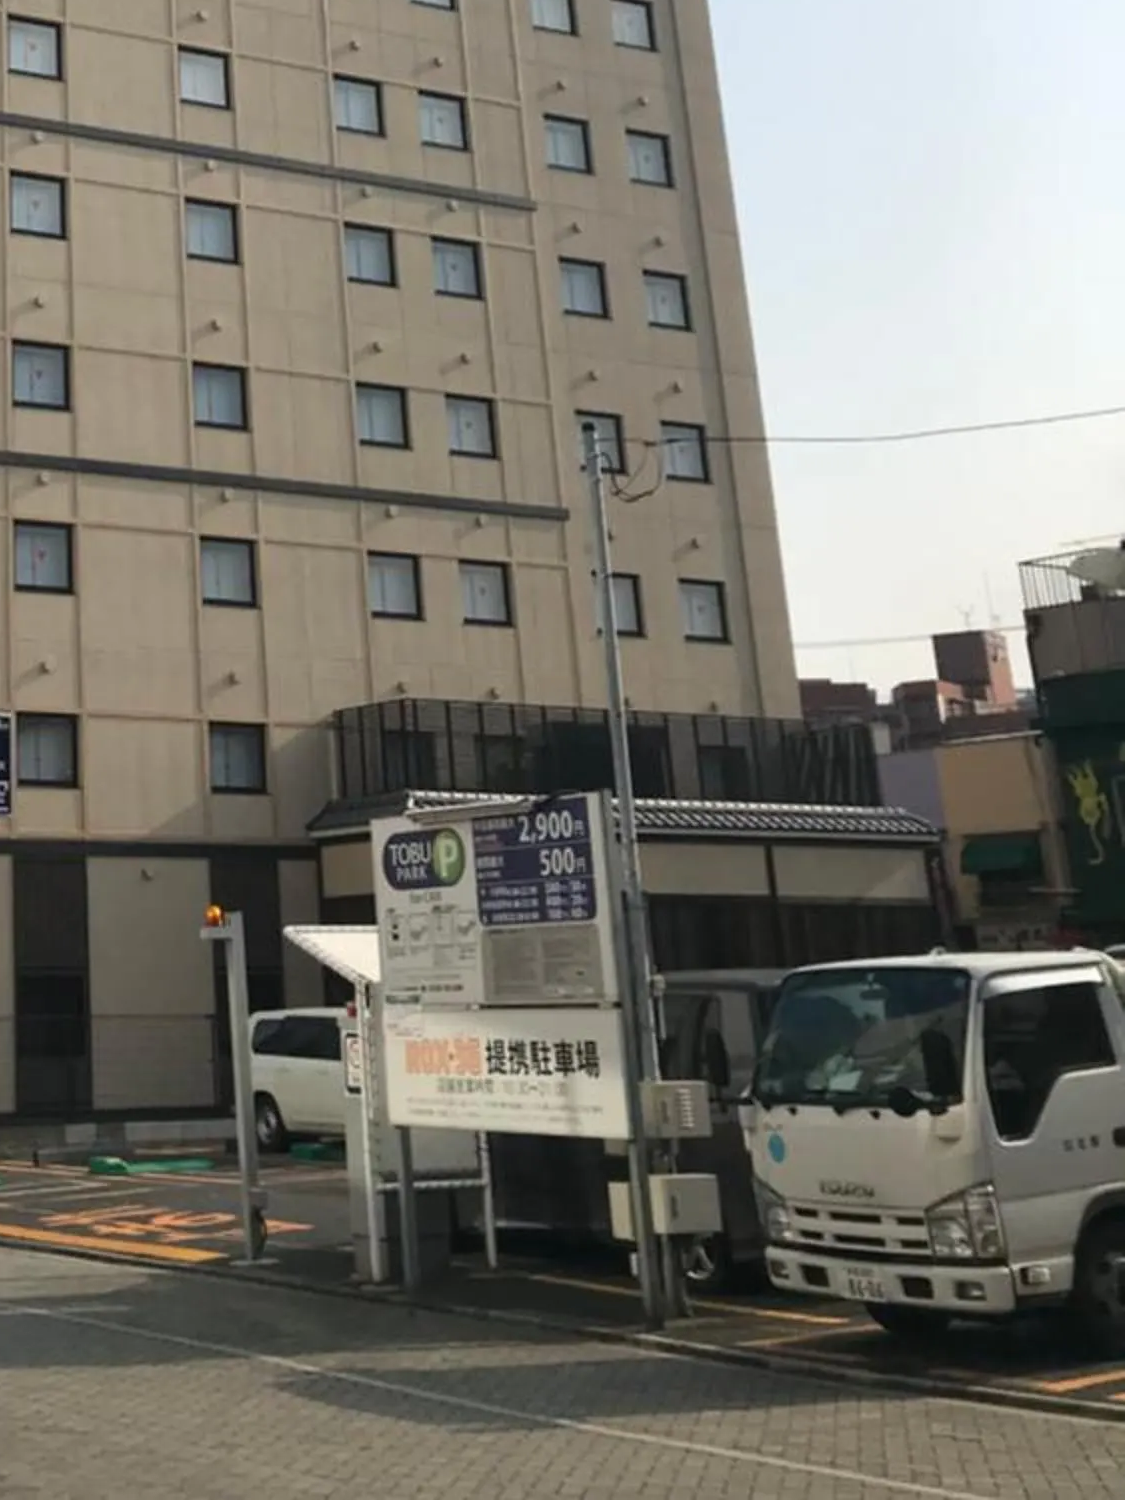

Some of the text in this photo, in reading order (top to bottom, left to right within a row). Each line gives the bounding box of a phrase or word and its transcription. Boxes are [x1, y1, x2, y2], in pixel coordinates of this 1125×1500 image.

[388, 840, 432, 866] TOBU
[438, 838, 459, 878] P
[396, 865, 428, 883] PARK
[485, 1038, 601, 1079] 提携駐車場
